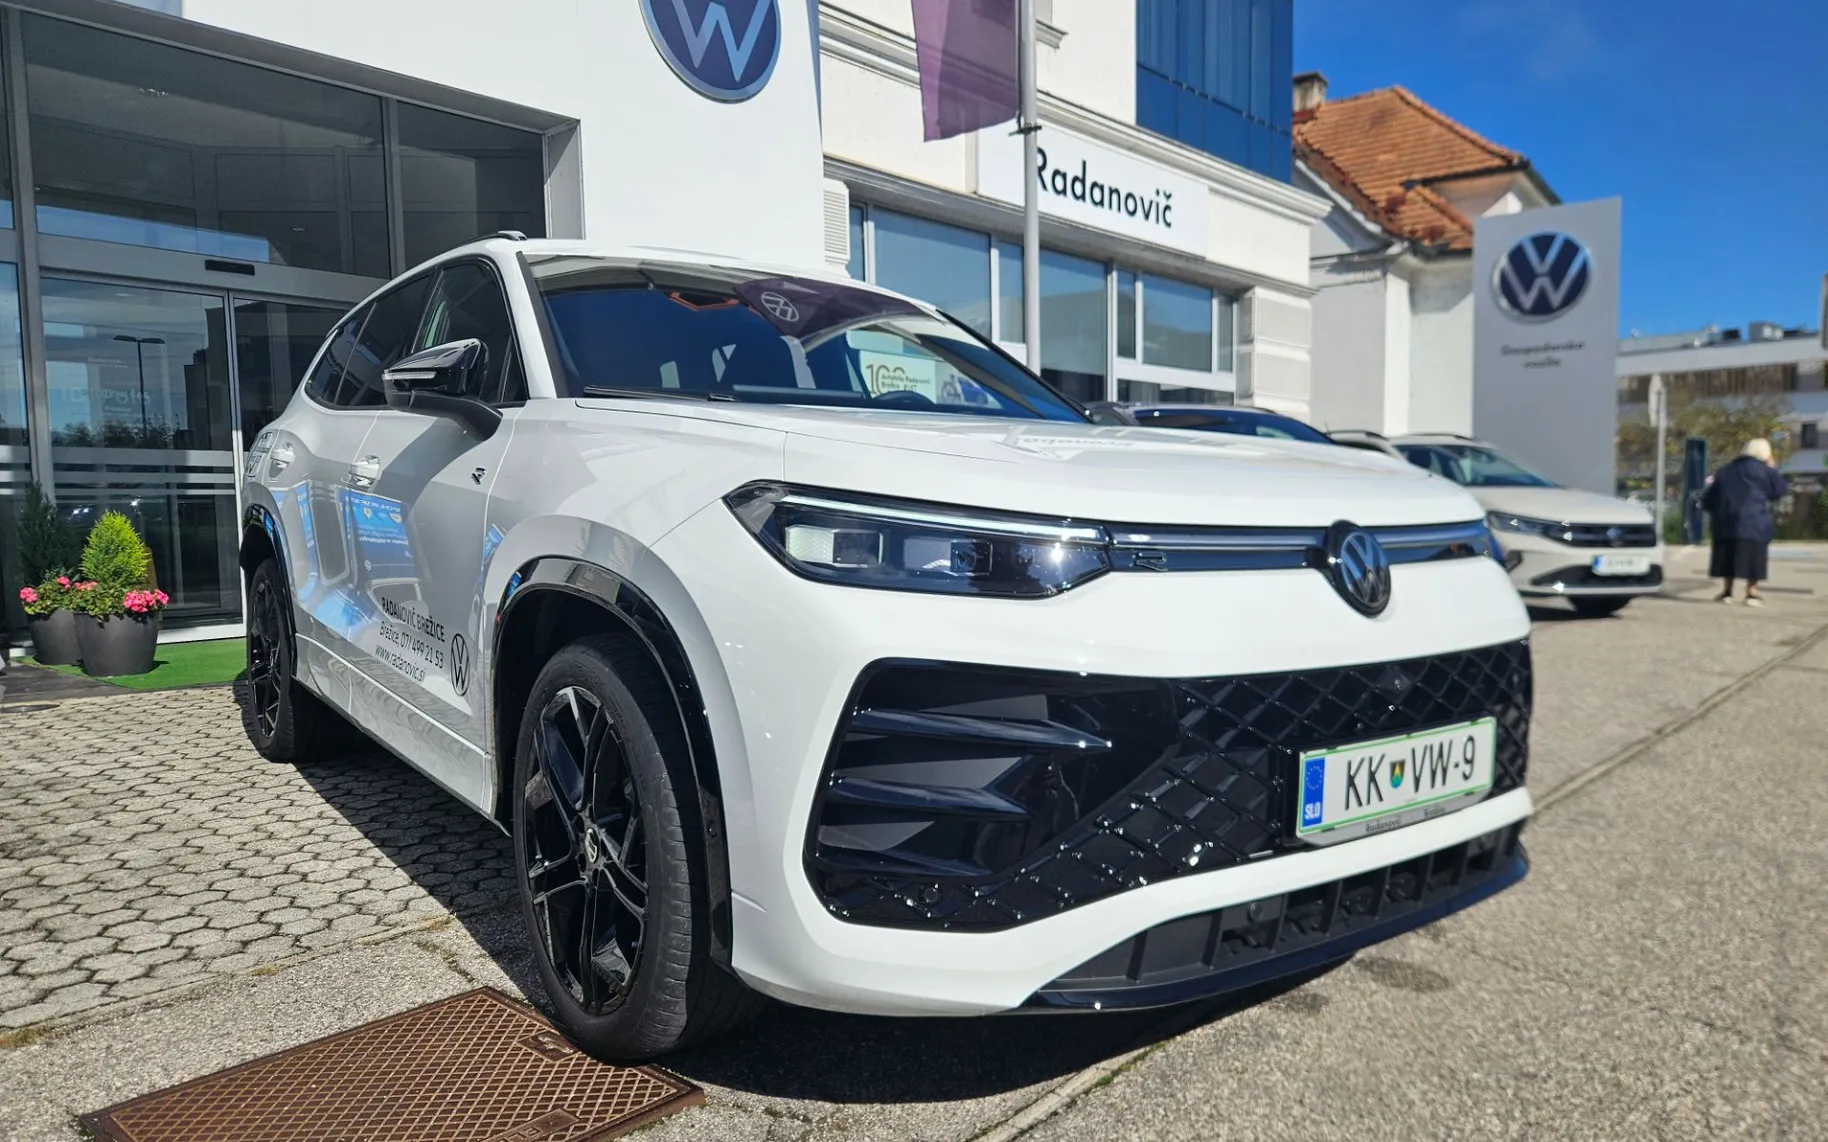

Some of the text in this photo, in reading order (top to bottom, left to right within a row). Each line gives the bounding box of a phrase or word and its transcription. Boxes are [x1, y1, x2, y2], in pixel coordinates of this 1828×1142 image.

[1037, 146, 1172, 228] Radanovič
[381, 596, 446, 643] RADANOVIČ BREŽICE
[1344, 734, 1476, 811] KK VW-9
[1304, 801, 1321, 820] SLO
